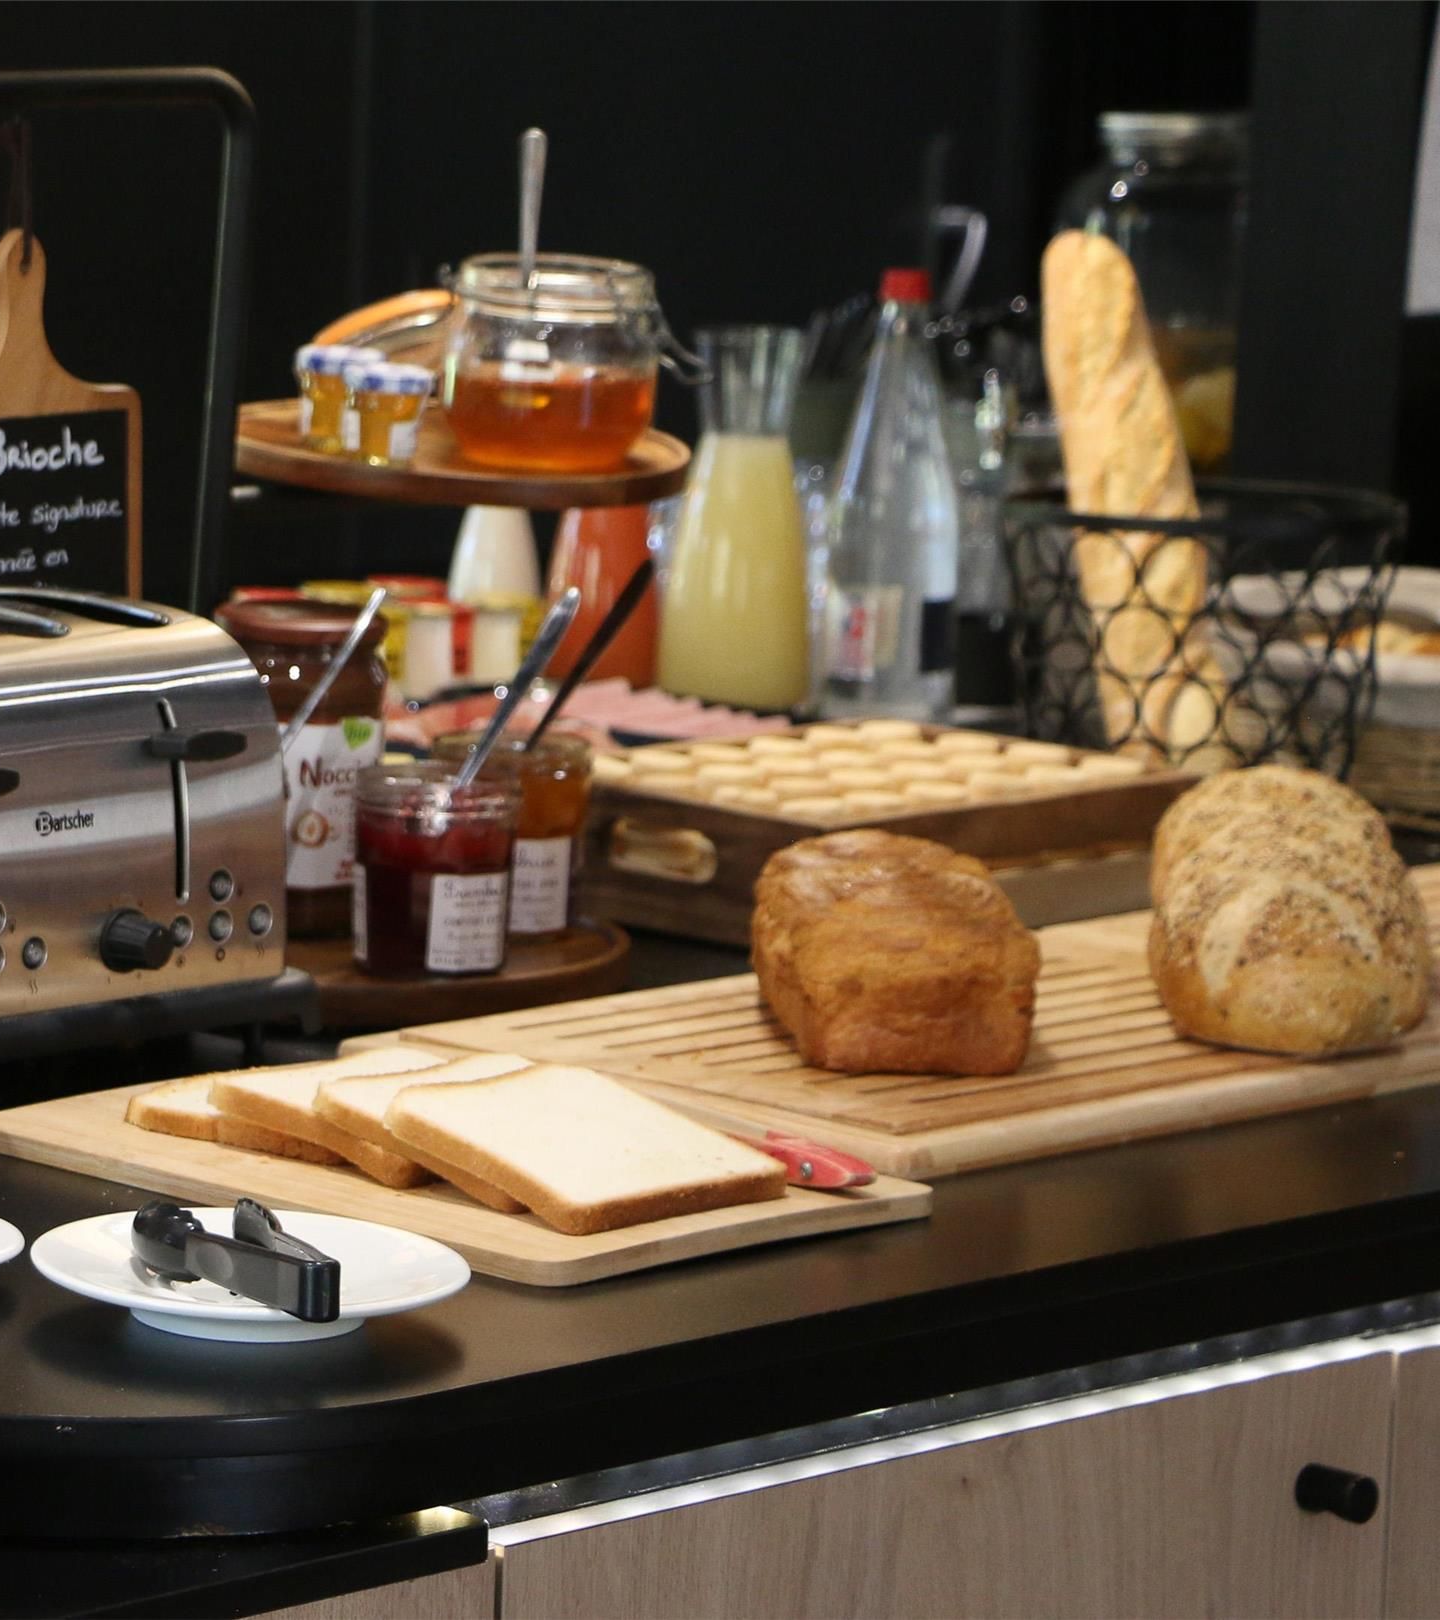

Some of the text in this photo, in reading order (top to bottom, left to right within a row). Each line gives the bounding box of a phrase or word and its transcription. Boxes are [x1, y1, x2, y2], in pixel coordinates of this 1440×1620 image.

[31, 497, 123, 533] signature
[43, 549, 69, 567] en
[35, 808, 94, 837] Bartscher
